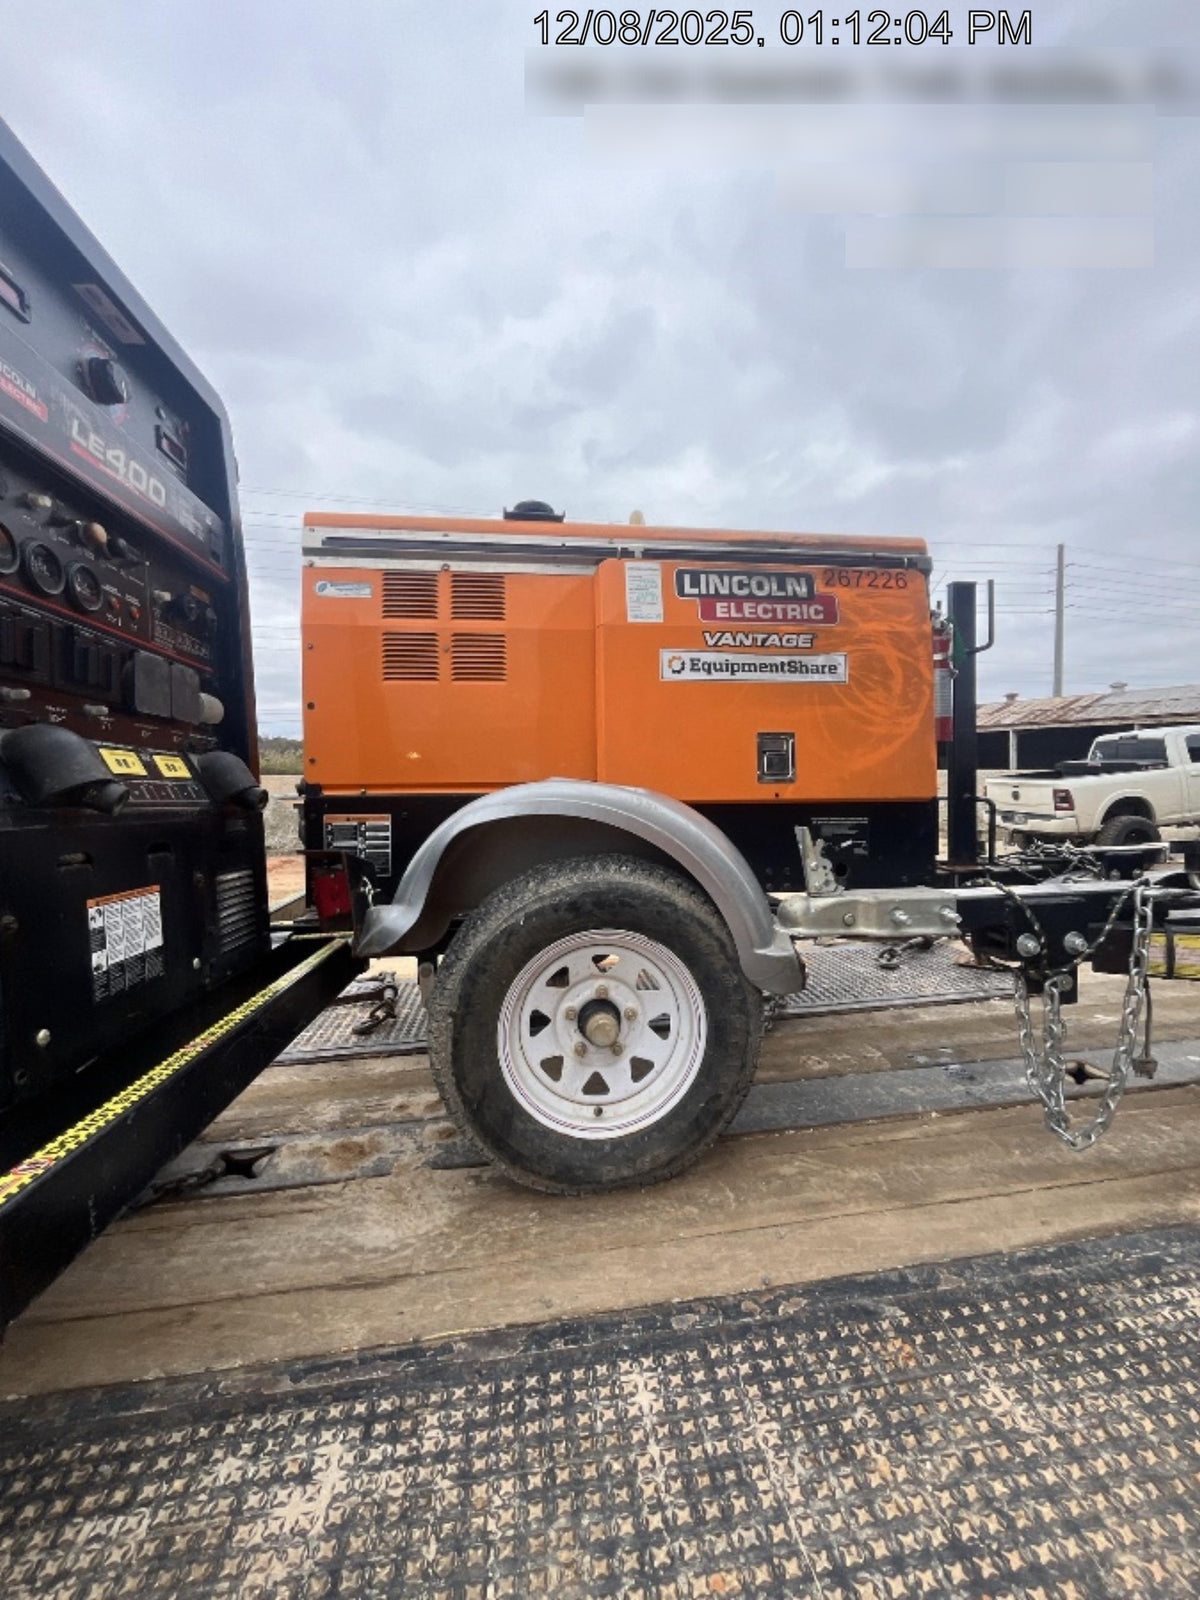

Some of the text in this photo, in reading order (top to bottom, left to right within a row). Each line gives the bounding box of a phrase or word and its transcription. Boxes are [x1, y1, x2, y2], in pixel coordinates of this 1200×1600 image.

[71, 418, 166, 507] LE400
[683, 573, 808, 598] LINCOLN
[823, 568, 908, 589] 267226
[715, 601, 824, 620] ELECTRIC
[703, 631, 815, 648] VANTAGE
[689, 657, 838, 675] EquipmentShare
